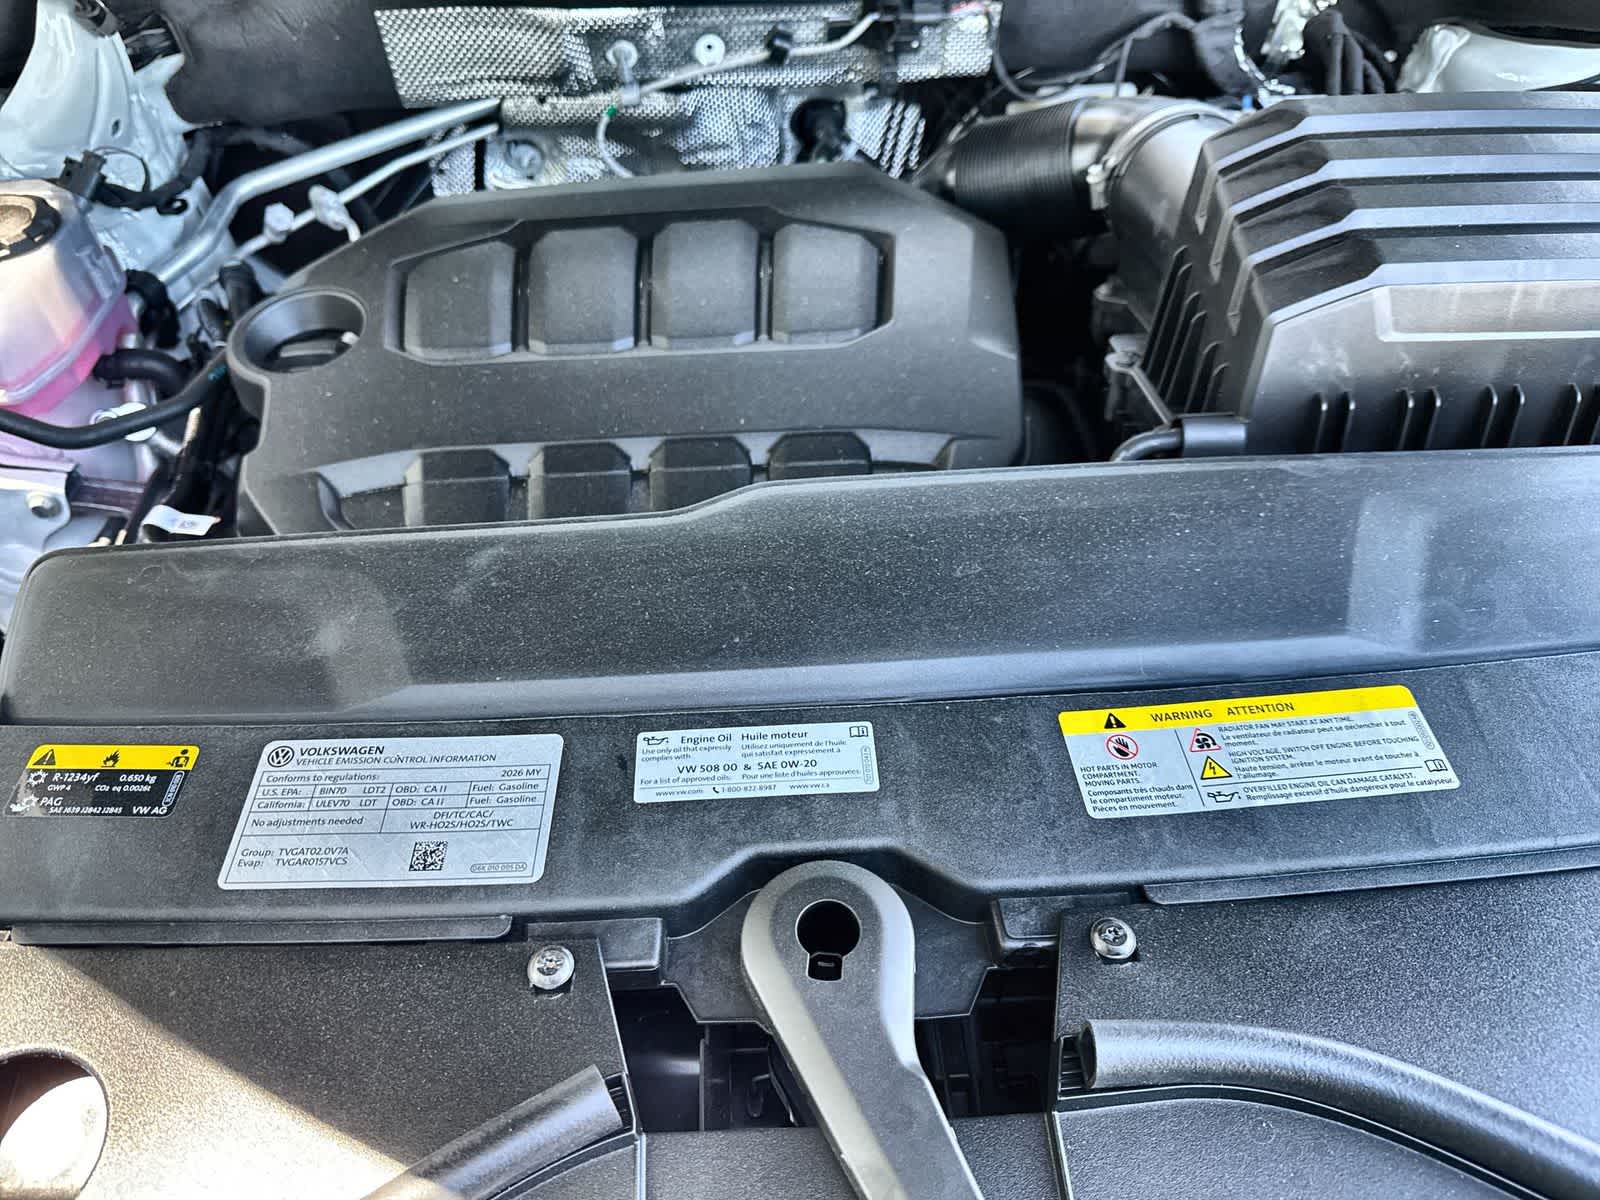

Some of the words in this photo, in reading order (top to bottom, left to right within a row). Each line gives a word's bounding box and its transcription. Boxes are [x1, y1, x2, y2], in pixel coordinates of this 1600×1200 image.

[1151, 709, 1213, 722] WARNING
[1227, 702, 1295, 716] ATTENTION
[1218, 725, 1254, 733] RADIATOR
[1232, 731, 1271, 740] ventilateur
[1283, 726, 1315, 735] radiateur
[1317, 725, 1334, 734] peut
[681, 735, 715, 745] Engine
[718, 734, 732, 742] Oil
[771, 731, 808, 739] moteur
[1281, 745, 1309, 755] SWITCH
[1326, 742, 1353, 750] ENGINE
[1354, 738, 1382, 746] BEFORE
[1383, 735, 1419, 744] TOUCHING
[300, 746, 384, 756] VOLKSWAGEN
[296, 757, 333, 765] VEHICLE
[336, 757, 381, 765] EMISSION
[384, 755, 428, 764] CONTROL
[430, 754, 496, 763] INFORMATION
[1231, 756, 1264, 764] IGNITION
[1235, 765, 1258, 773] Haute
[1259, 763, 1289, 771] tension,
[1290, 759, 1315, 767] arrêter
[1324, 758, 1350, 766] moteur
[1385, 751, 1413, 759] toucher
[677, 765, 696, 773] VW
[700, 764, 720, 772] 508
[723, 763, 737, 771] 00
[758, 761, 777, 769] SAE
[781, 760, 817, 768] 0W-20
[501, 769, 524, 777] 2026
[52, 772, 100, 784] R-1234yf
[119, 774, 144, 782] 0.650
[145, 774, 157, 783] kg
[266, 775, 310, 783] Conforms
[324, 773, 380, 783] regulations:
[681, 775, 715, 783] approved
[1243, 784, 1287, 793] OVERFILLED
[1289, 781, 1316, 790] ENGINE
[1331, 778, 1347, 786] CAN
[1348, 776, 1378, 784] DAMAGE
[1379, 772, 1416, 780] CATALYST.
[499, 783, 539, 791] Gasoline
[1085, 779, 1115, 787] MOVING
[1088, 788, 1132, 797] Composants
[1246, 791, 1291, 800] Remplissage
[1294, 788, 1322, 798] excessif
[1324, 786, 1349, 794] d'huile
[1351, 782, 1389, 792] dangereux
[1390, 781, 1406, 789] pour
[40, 797, 63, 806] PAG
[392, 798, 416, 806] OBD:
[497, 795, 536, 803] Gasoline
[1099, 795, 1153, 804] compartiment
[1154, 792, 1184, 800] moteur.
[257, 801, 305, 809] California:
[1130, 801, 1178, 810] mouvement.
[434, 810, 494, 819] DFI/TC/CAC/
[252, 819, 265, 827] No
[266, 818, 326, 828] adjustments
[328, 816, 364, 825] needed
[410, 819, 514, 829] WR-HO2S/HO2S/TWC
[241, 849, 273, 857] Group:
[238, 859, 264, 868] Evap:
